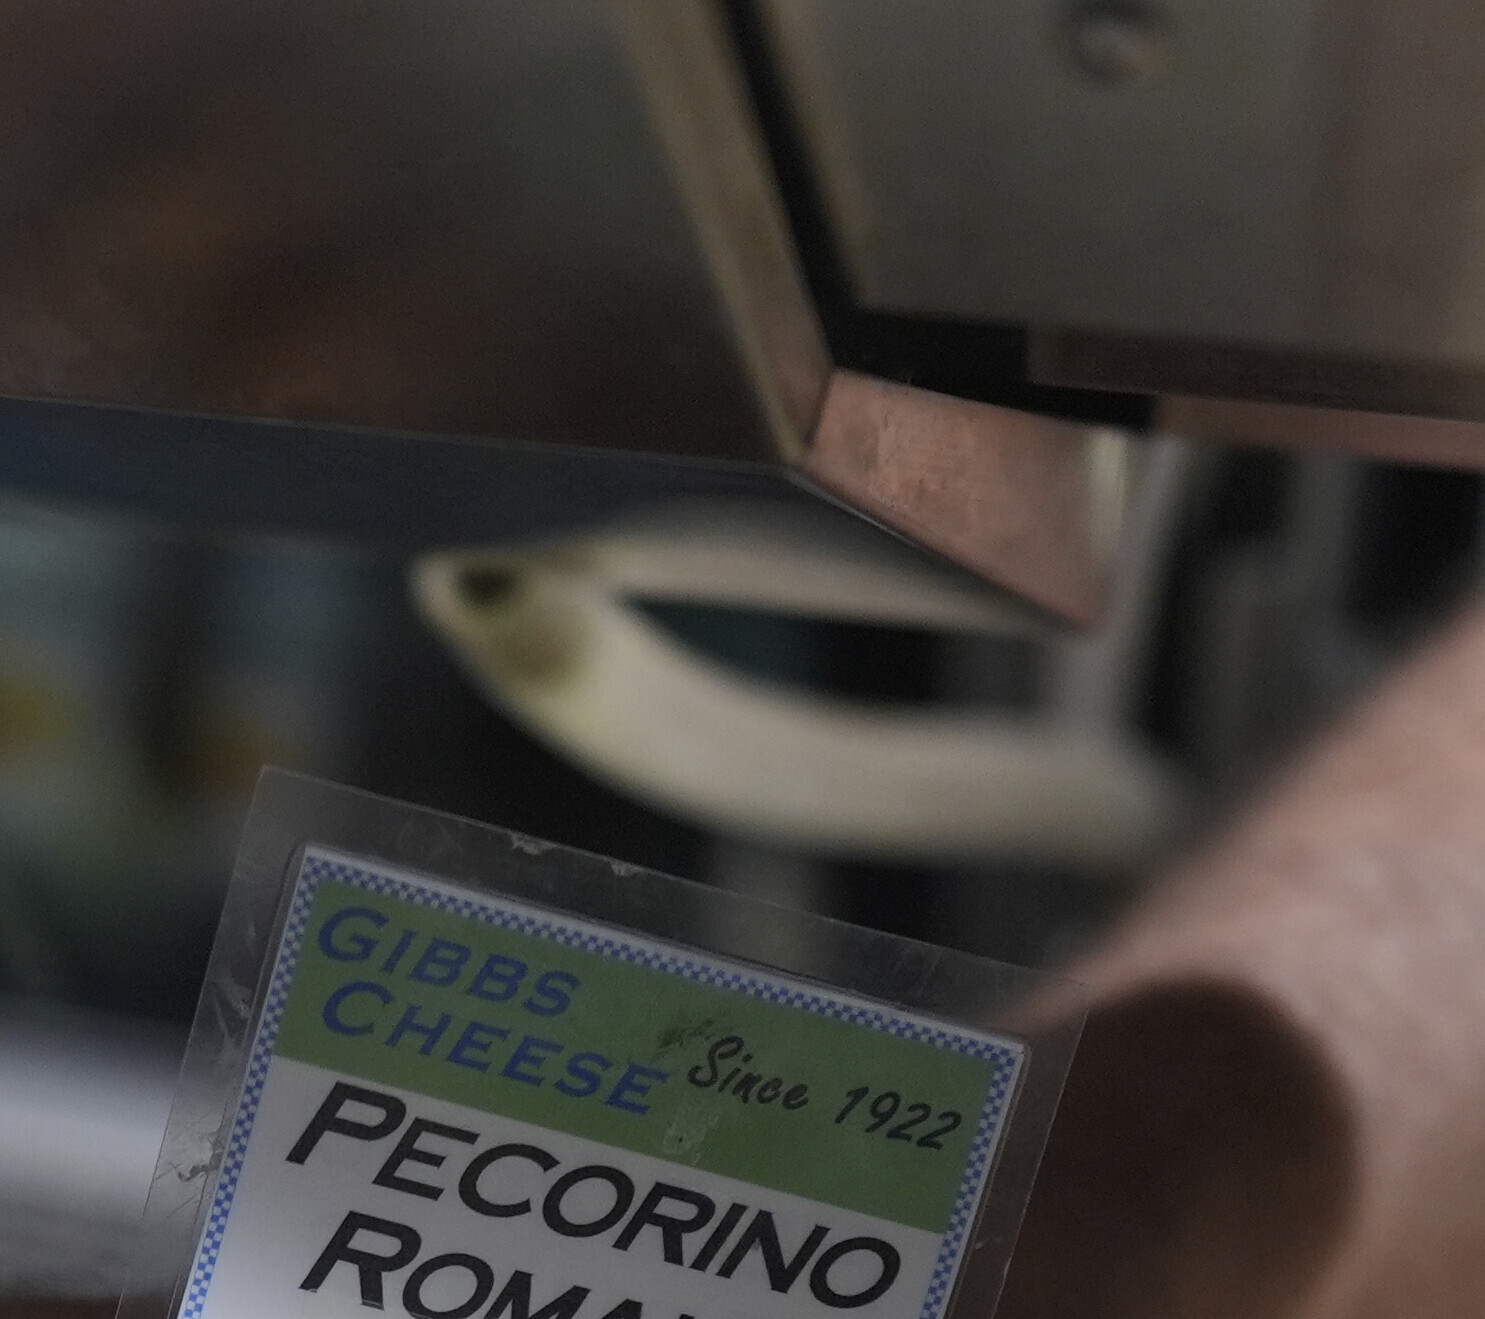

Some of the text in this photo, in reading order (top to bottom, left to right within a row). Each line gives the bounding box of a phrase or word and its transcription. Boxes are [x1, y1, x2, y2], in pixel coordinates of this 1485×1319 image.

[316, 905, 580, 1018] GIBBS
[322, 980, 962, 1151] CHEESE Since 1922
[285, 1079, 902, 1310] PECORINO
